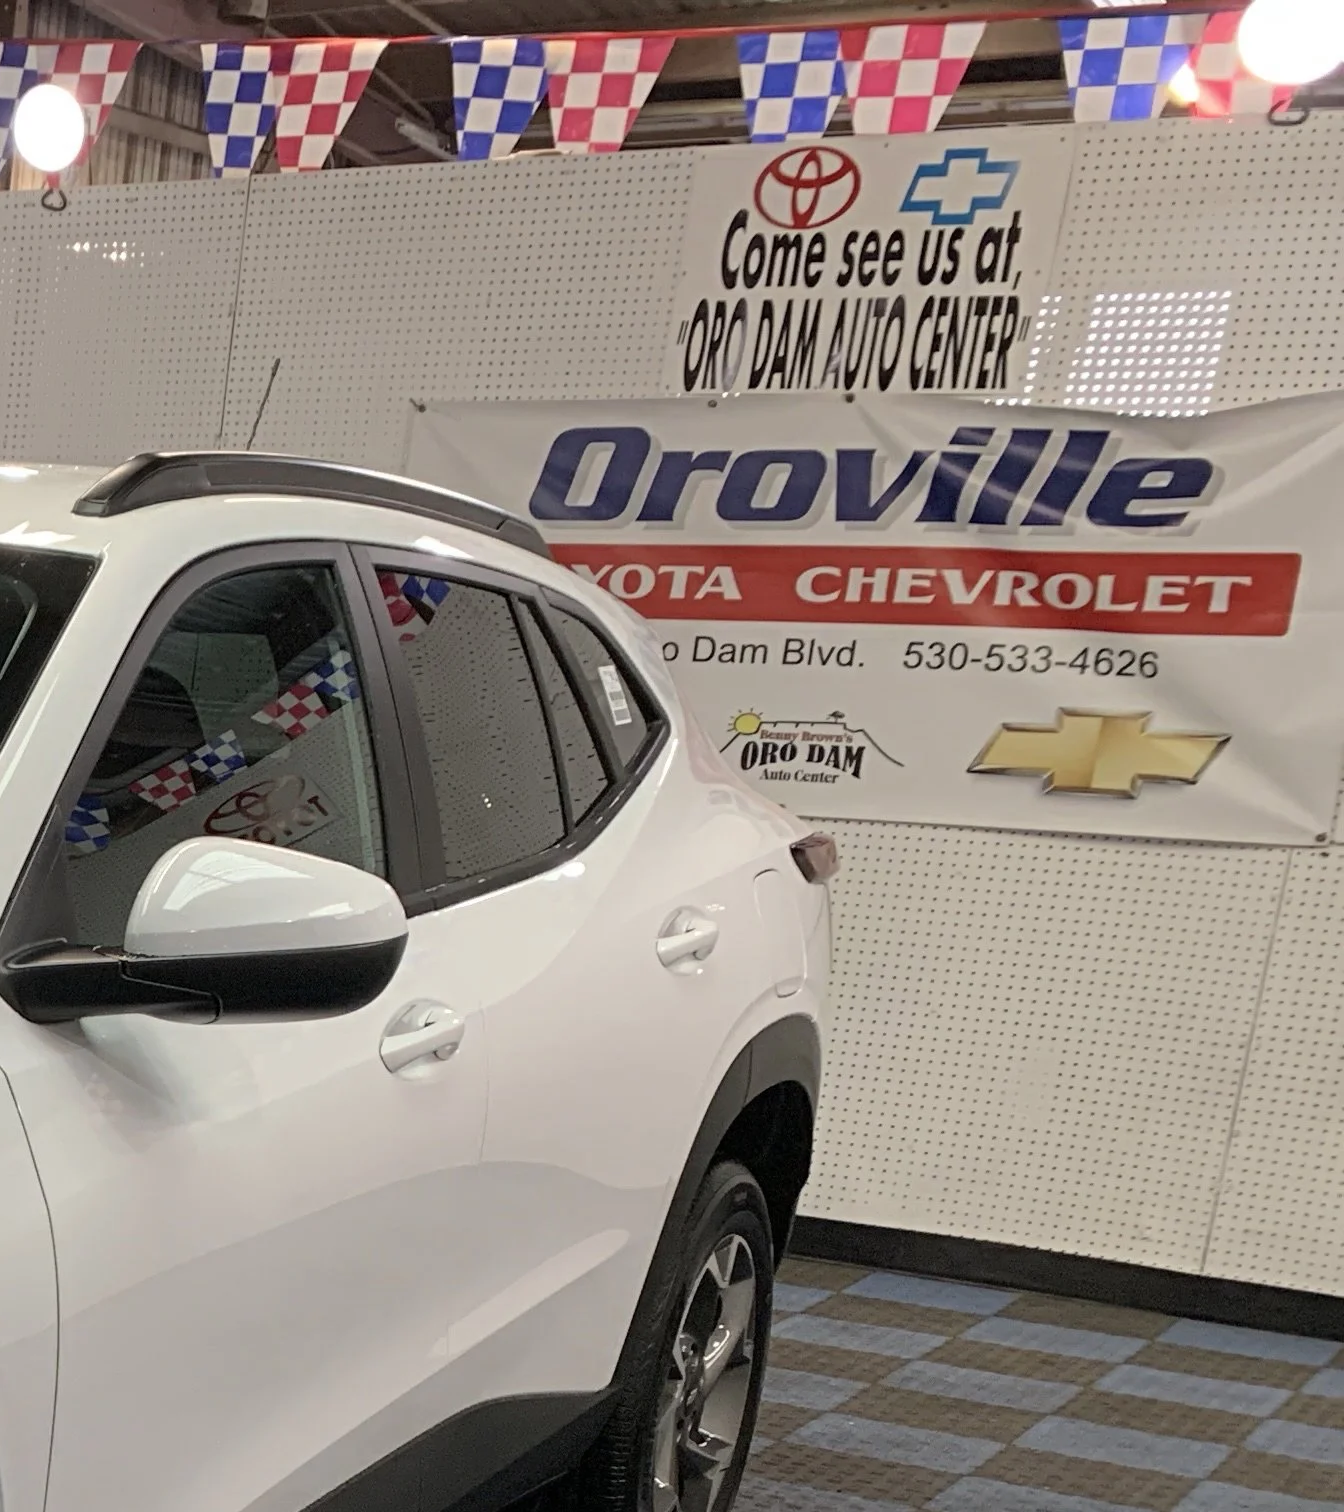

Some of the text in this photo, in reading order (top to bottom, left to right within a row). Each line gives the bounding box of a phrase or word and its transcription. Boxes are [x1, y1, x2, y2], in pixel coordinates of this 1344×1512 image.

[720, 209, 1022, 291] Come see us at,
[677, 295, 1032, 392] "ORO DAM AUTO CENTER"
[528, 426, 1214, 528] Oroville
[571, 564, 1253, 613] YOTA CHEVROLET
[692, 636, 769, 664] Dam
[782, 638, 865, 667] Blvd.
[903, 641, 1160, 679] 530-533-4626
[759, 729, 853, 744] Benny Brown's
[741, 741, 867, 779] ORO DAM
[759, 769, 839, 783] Auto Center
